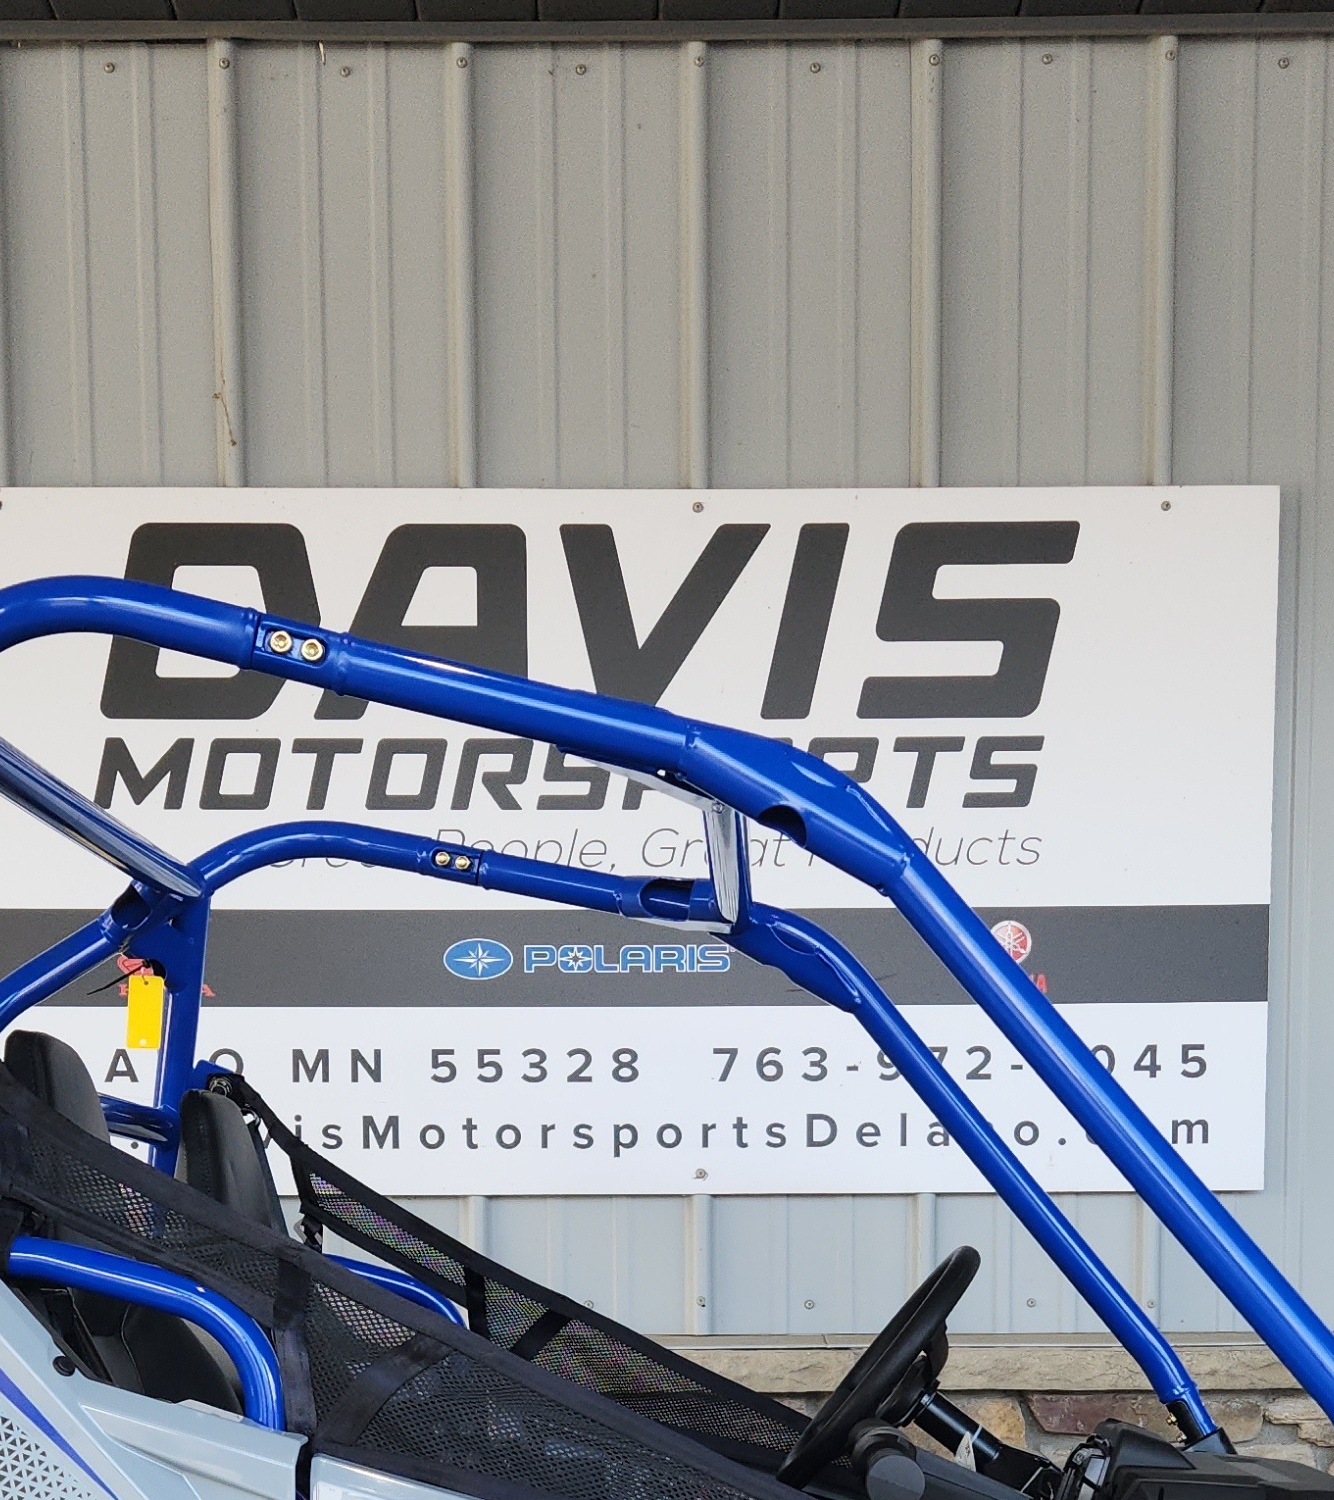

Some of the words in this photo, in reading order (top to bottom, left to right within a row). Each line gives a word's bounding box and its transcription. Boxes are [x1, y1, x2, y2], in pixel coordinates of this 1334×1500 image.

[100, 521, 1080, 719] DAVIS
[93, 735, 1045, 811] MOTORSTS
[642, 827, 786, 868] Grat
[524, 944, 731, 973] POLARIS
[292, 1048, 382, 1083] MN
[430, 1047, 640, 1084] 55328
[712, 1043, 1207, 1083] 763-972-045
